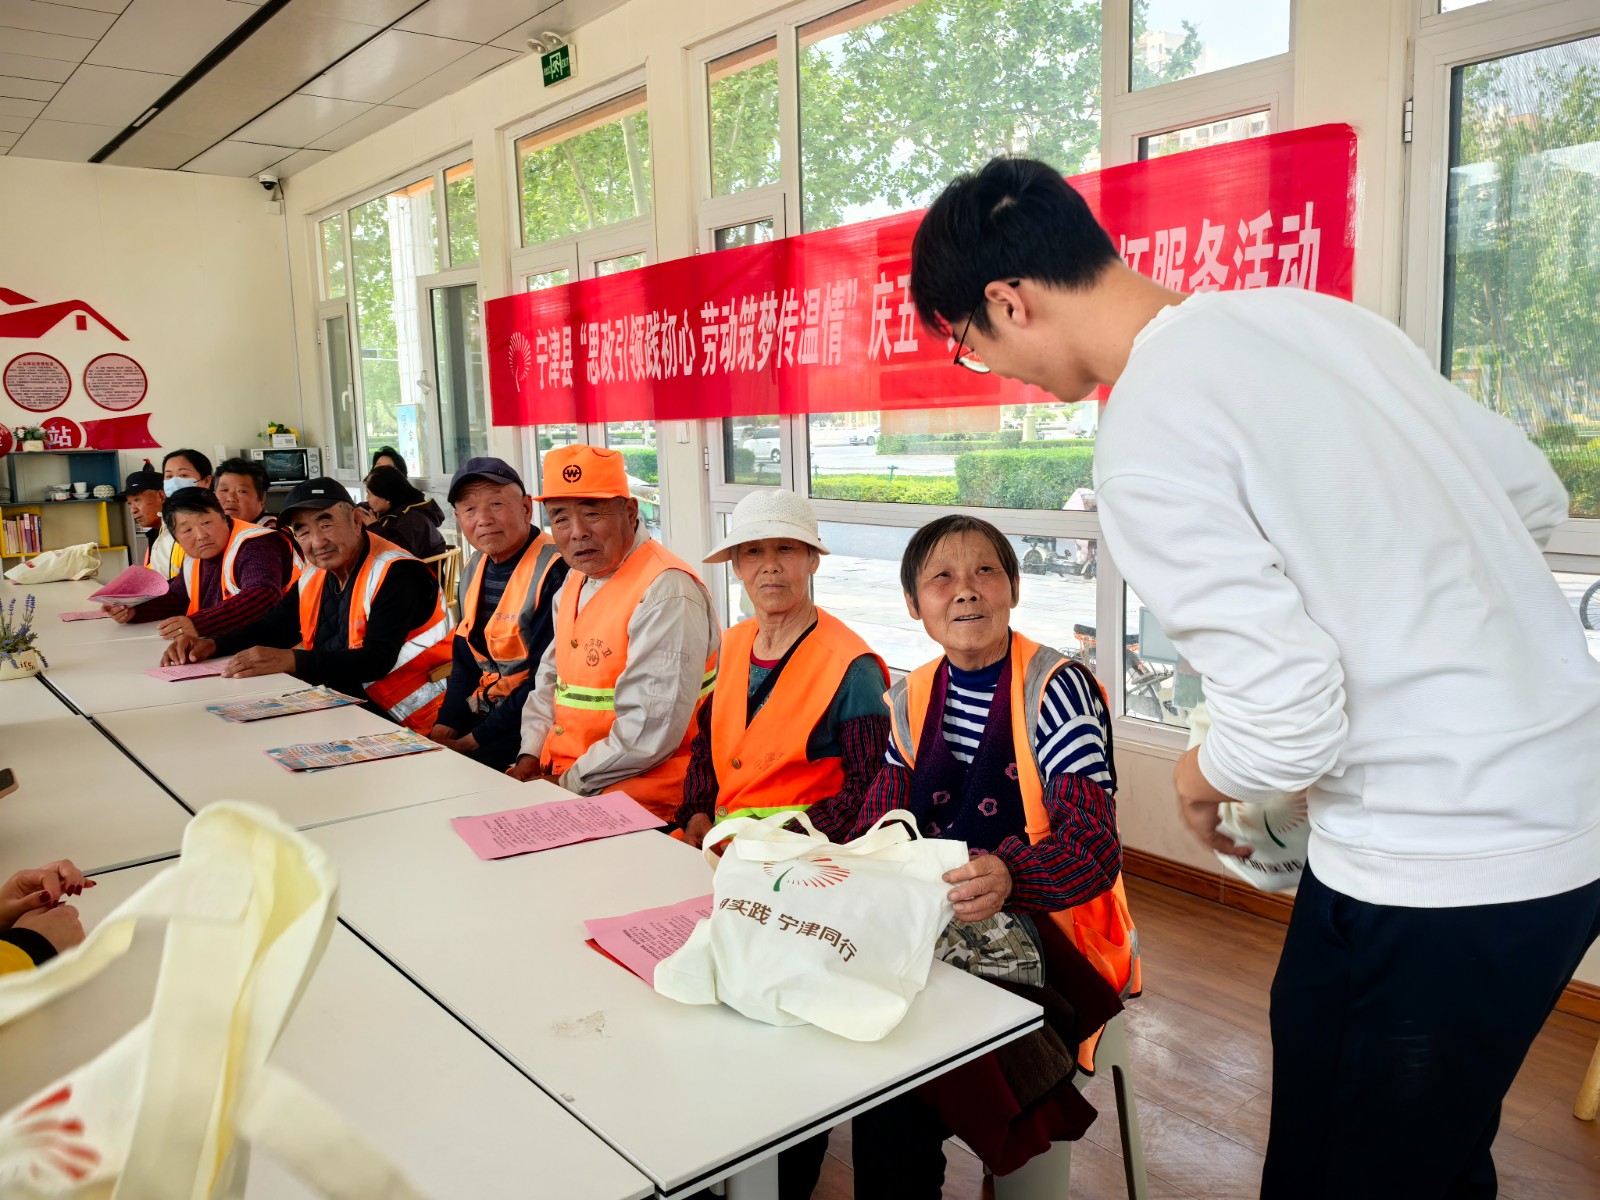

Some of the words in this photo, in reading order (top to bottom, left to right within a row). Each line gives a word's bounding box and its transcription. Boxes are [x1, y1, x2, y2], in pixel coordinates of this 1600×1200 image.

[47, 425, 72, 447] 站
[777, 913, 858, 963] 宁津同行
